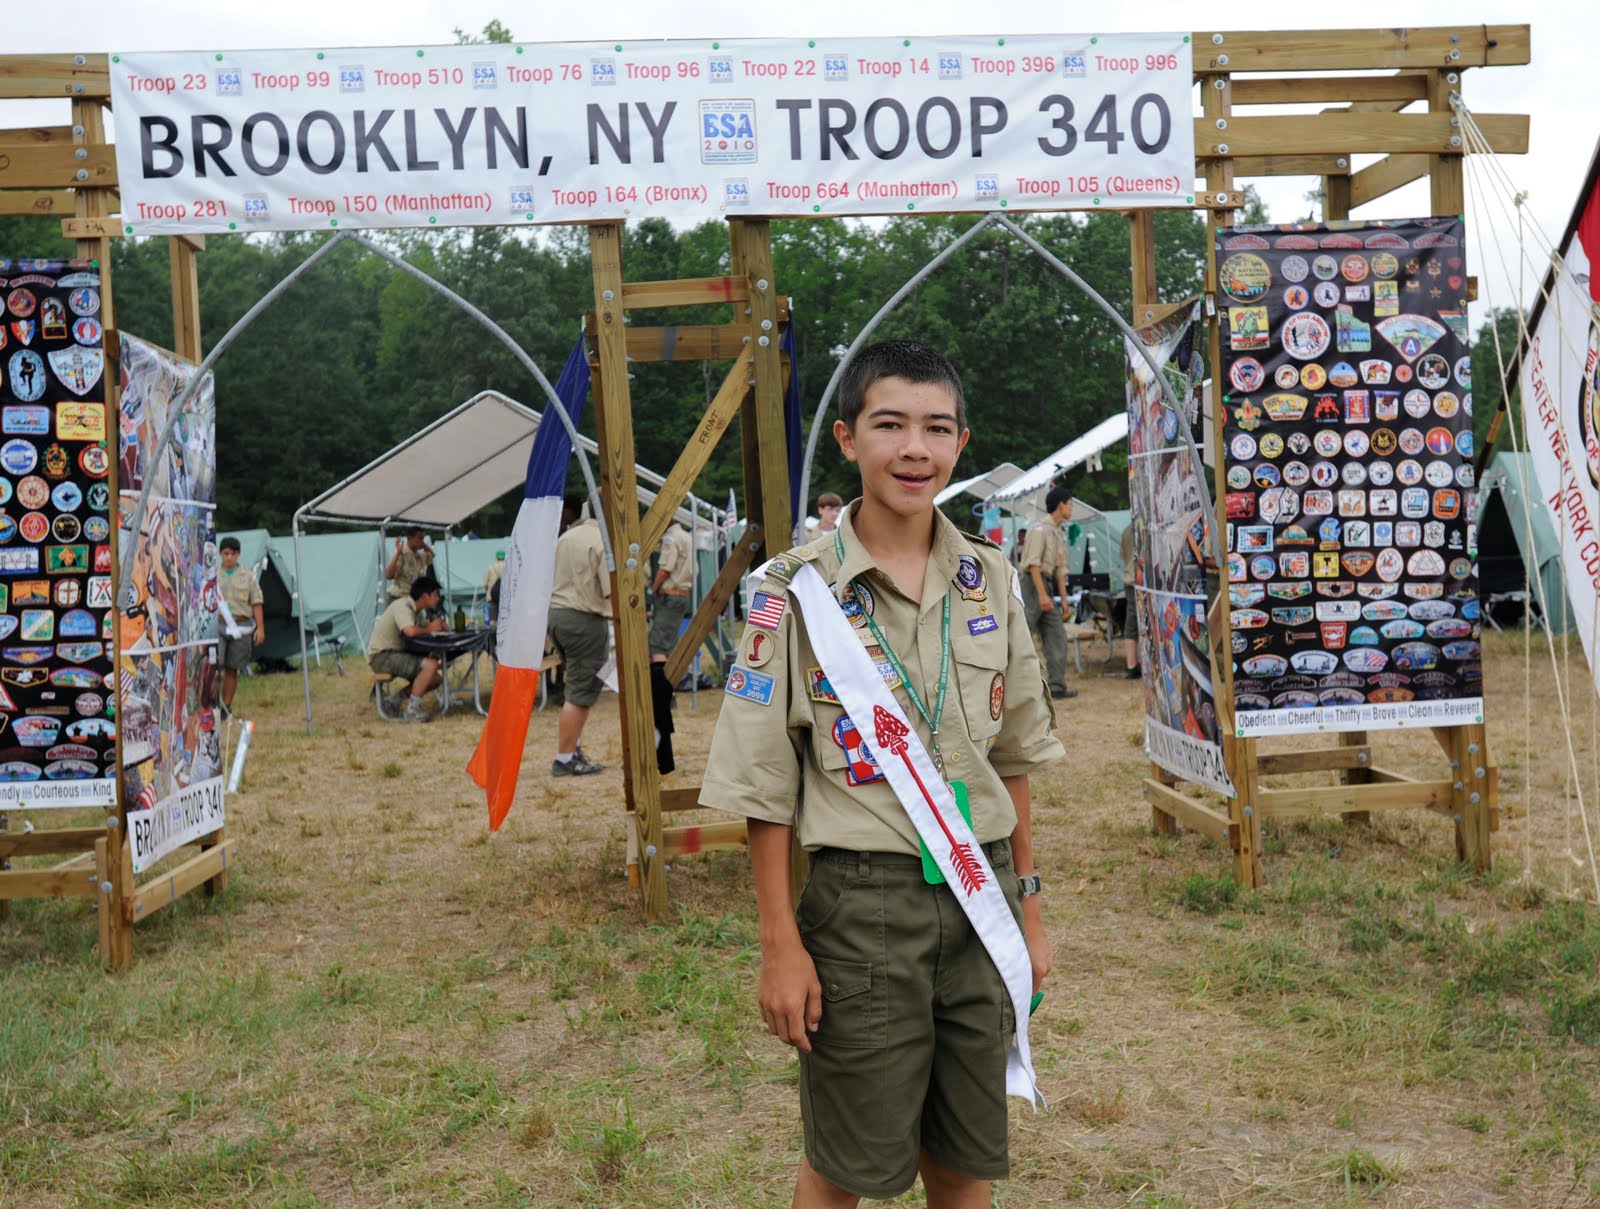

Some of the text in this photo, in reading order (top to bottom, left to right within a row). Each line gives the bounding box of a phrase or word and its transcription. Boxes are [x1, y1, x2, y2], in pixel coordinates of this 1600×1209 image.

[129, 76, 176, 93] Troop
[184, 74, 206, 90] 23
[253, 72, 299, 90] Troop
[307, 71, 330, 87] 99
[377, 70, 422, 88] Troop
[429, 67, 463, 84] 510
[508, 66, 553, 83] Troop
[562, 64, 582, 80] 76
[626, 64, 671, 79] Troop
[678, 61, 700, 78] 96
[743, 60, 787, 79] Troop
[795, 60, 815, 76] 22
[858, 59, 902, 76] Troop
[912, 58, 929, 73] 14
[972, 58, 1015, 75] Troop
[1023, 57, 1054, 72] 396
[1097, 56, 1139, 73] Troop
[1145, 54, 1178, 70] 996
[140, 102, 677, 179] BROOKLYN, NY
[775, 94, 1171, 160] TROOP 340
[138, 203, 186, 221] Troop
[194, 200, 227, 218] 281
[288, 197, 336, 216] Troop
[344, 195, 377, 213] 150
[385, 193, 492, 212] (Manhattan)
[552, 190, 597, 206] Troop
[607, 186, 637, 203] 164
[646, 185, 707, 203] (Bronx)
[768, 182, 811, 202] Troop
[817, 182, 849, 198] 664
[857, 181, 958, 200] (Manhattan)
[1017, 178, 1061, 197] Troop
[1069, 176, 1099, 192] 105
[1106, 176, 1180, 195] (Queens)
[1405, 339, 1416, 354] A
[698, 410, 718, 444] FRONT
[1566, 477, 1592, 542] YORK
[747, 690, 764, 700] 2009
[1238, 702, 1480, 728] Obedient Cheerful Thrifty Brave Clean Reverent
[34, 784, 80, 799] Courteous
[92, 782, 112, 796] Kind
[180, 789, 204, 830] TROOP
